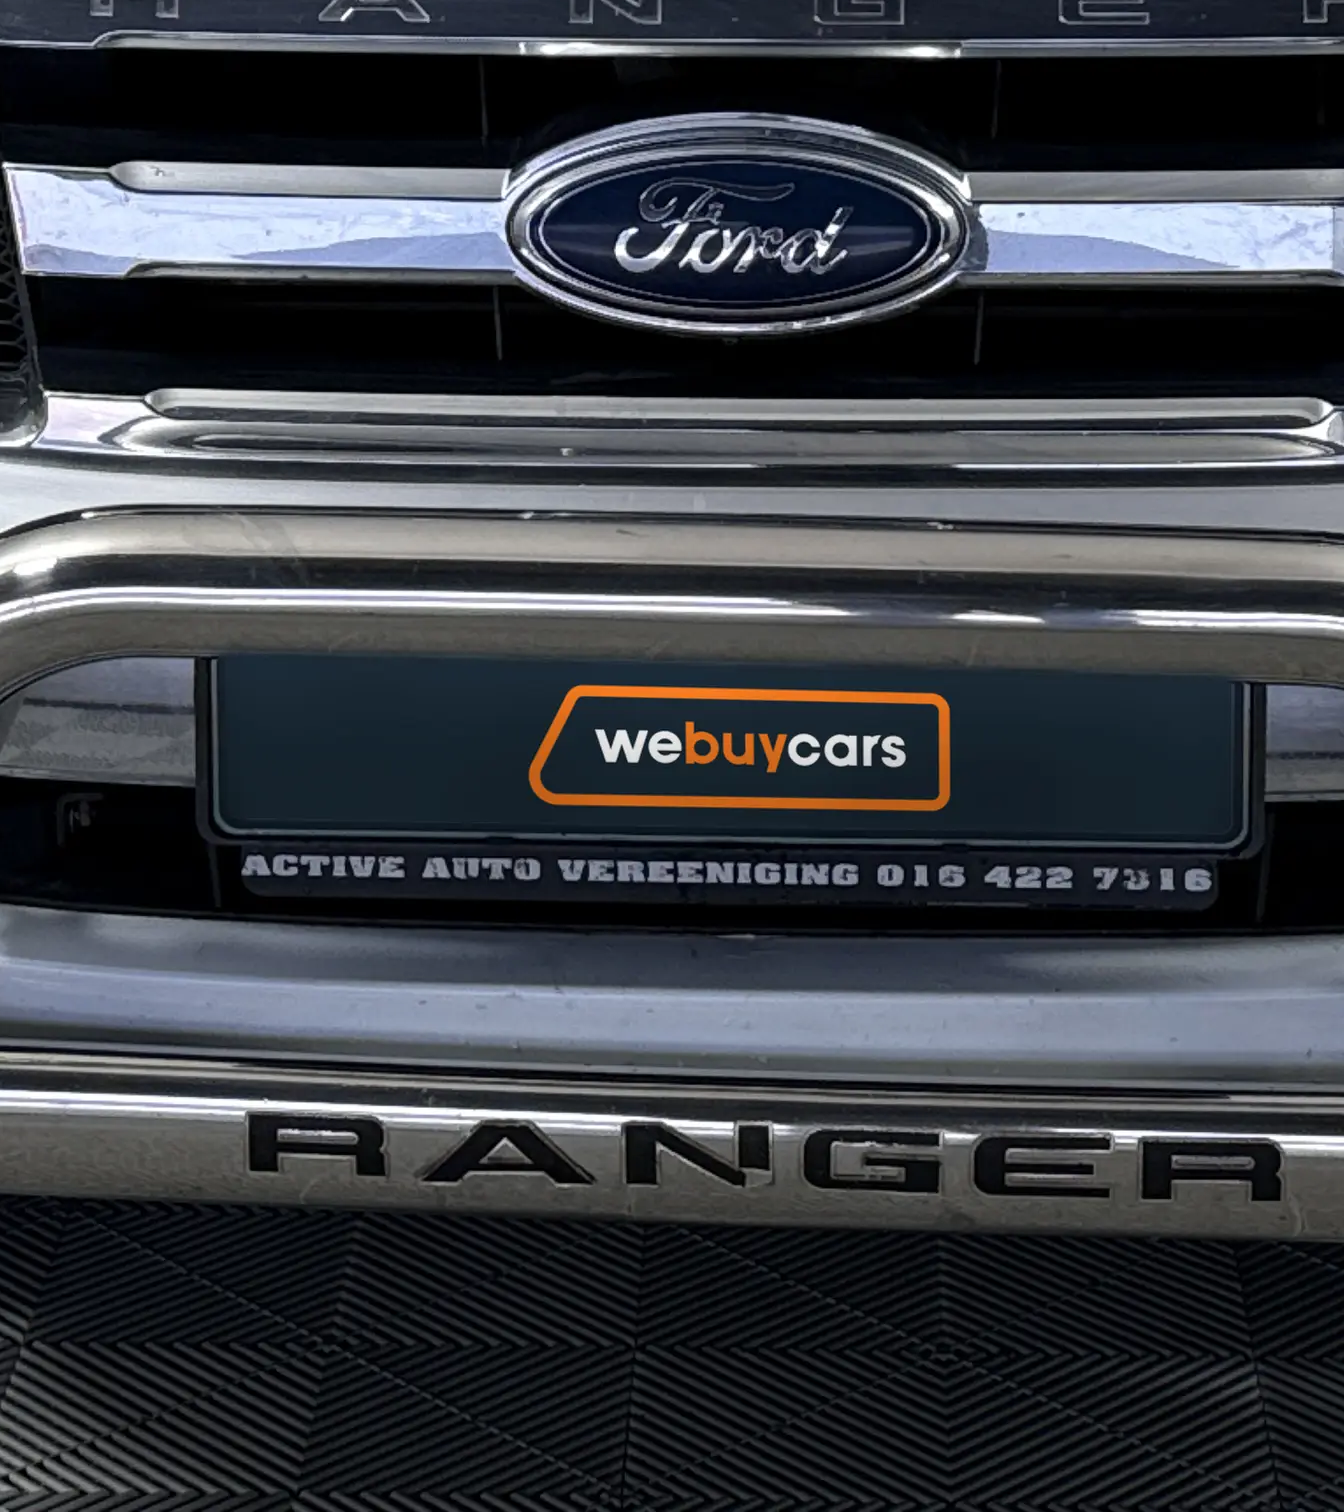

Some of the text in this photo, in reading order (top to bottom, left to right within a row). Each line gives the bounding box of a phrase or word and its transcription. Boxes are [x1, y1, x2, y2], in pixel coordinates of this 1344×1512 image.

[614, 177, 854, 276] Ford
[241, 854, 405, 879] ACTIVE
[421, 857, 542, 881] AUTO
[557, 860, 859, 887] VEREENIGING
[876, 863, 966, 888] 016
[983, 865, 1074, 889] 422
[247, 1111, 1286, 1202] RANGER
